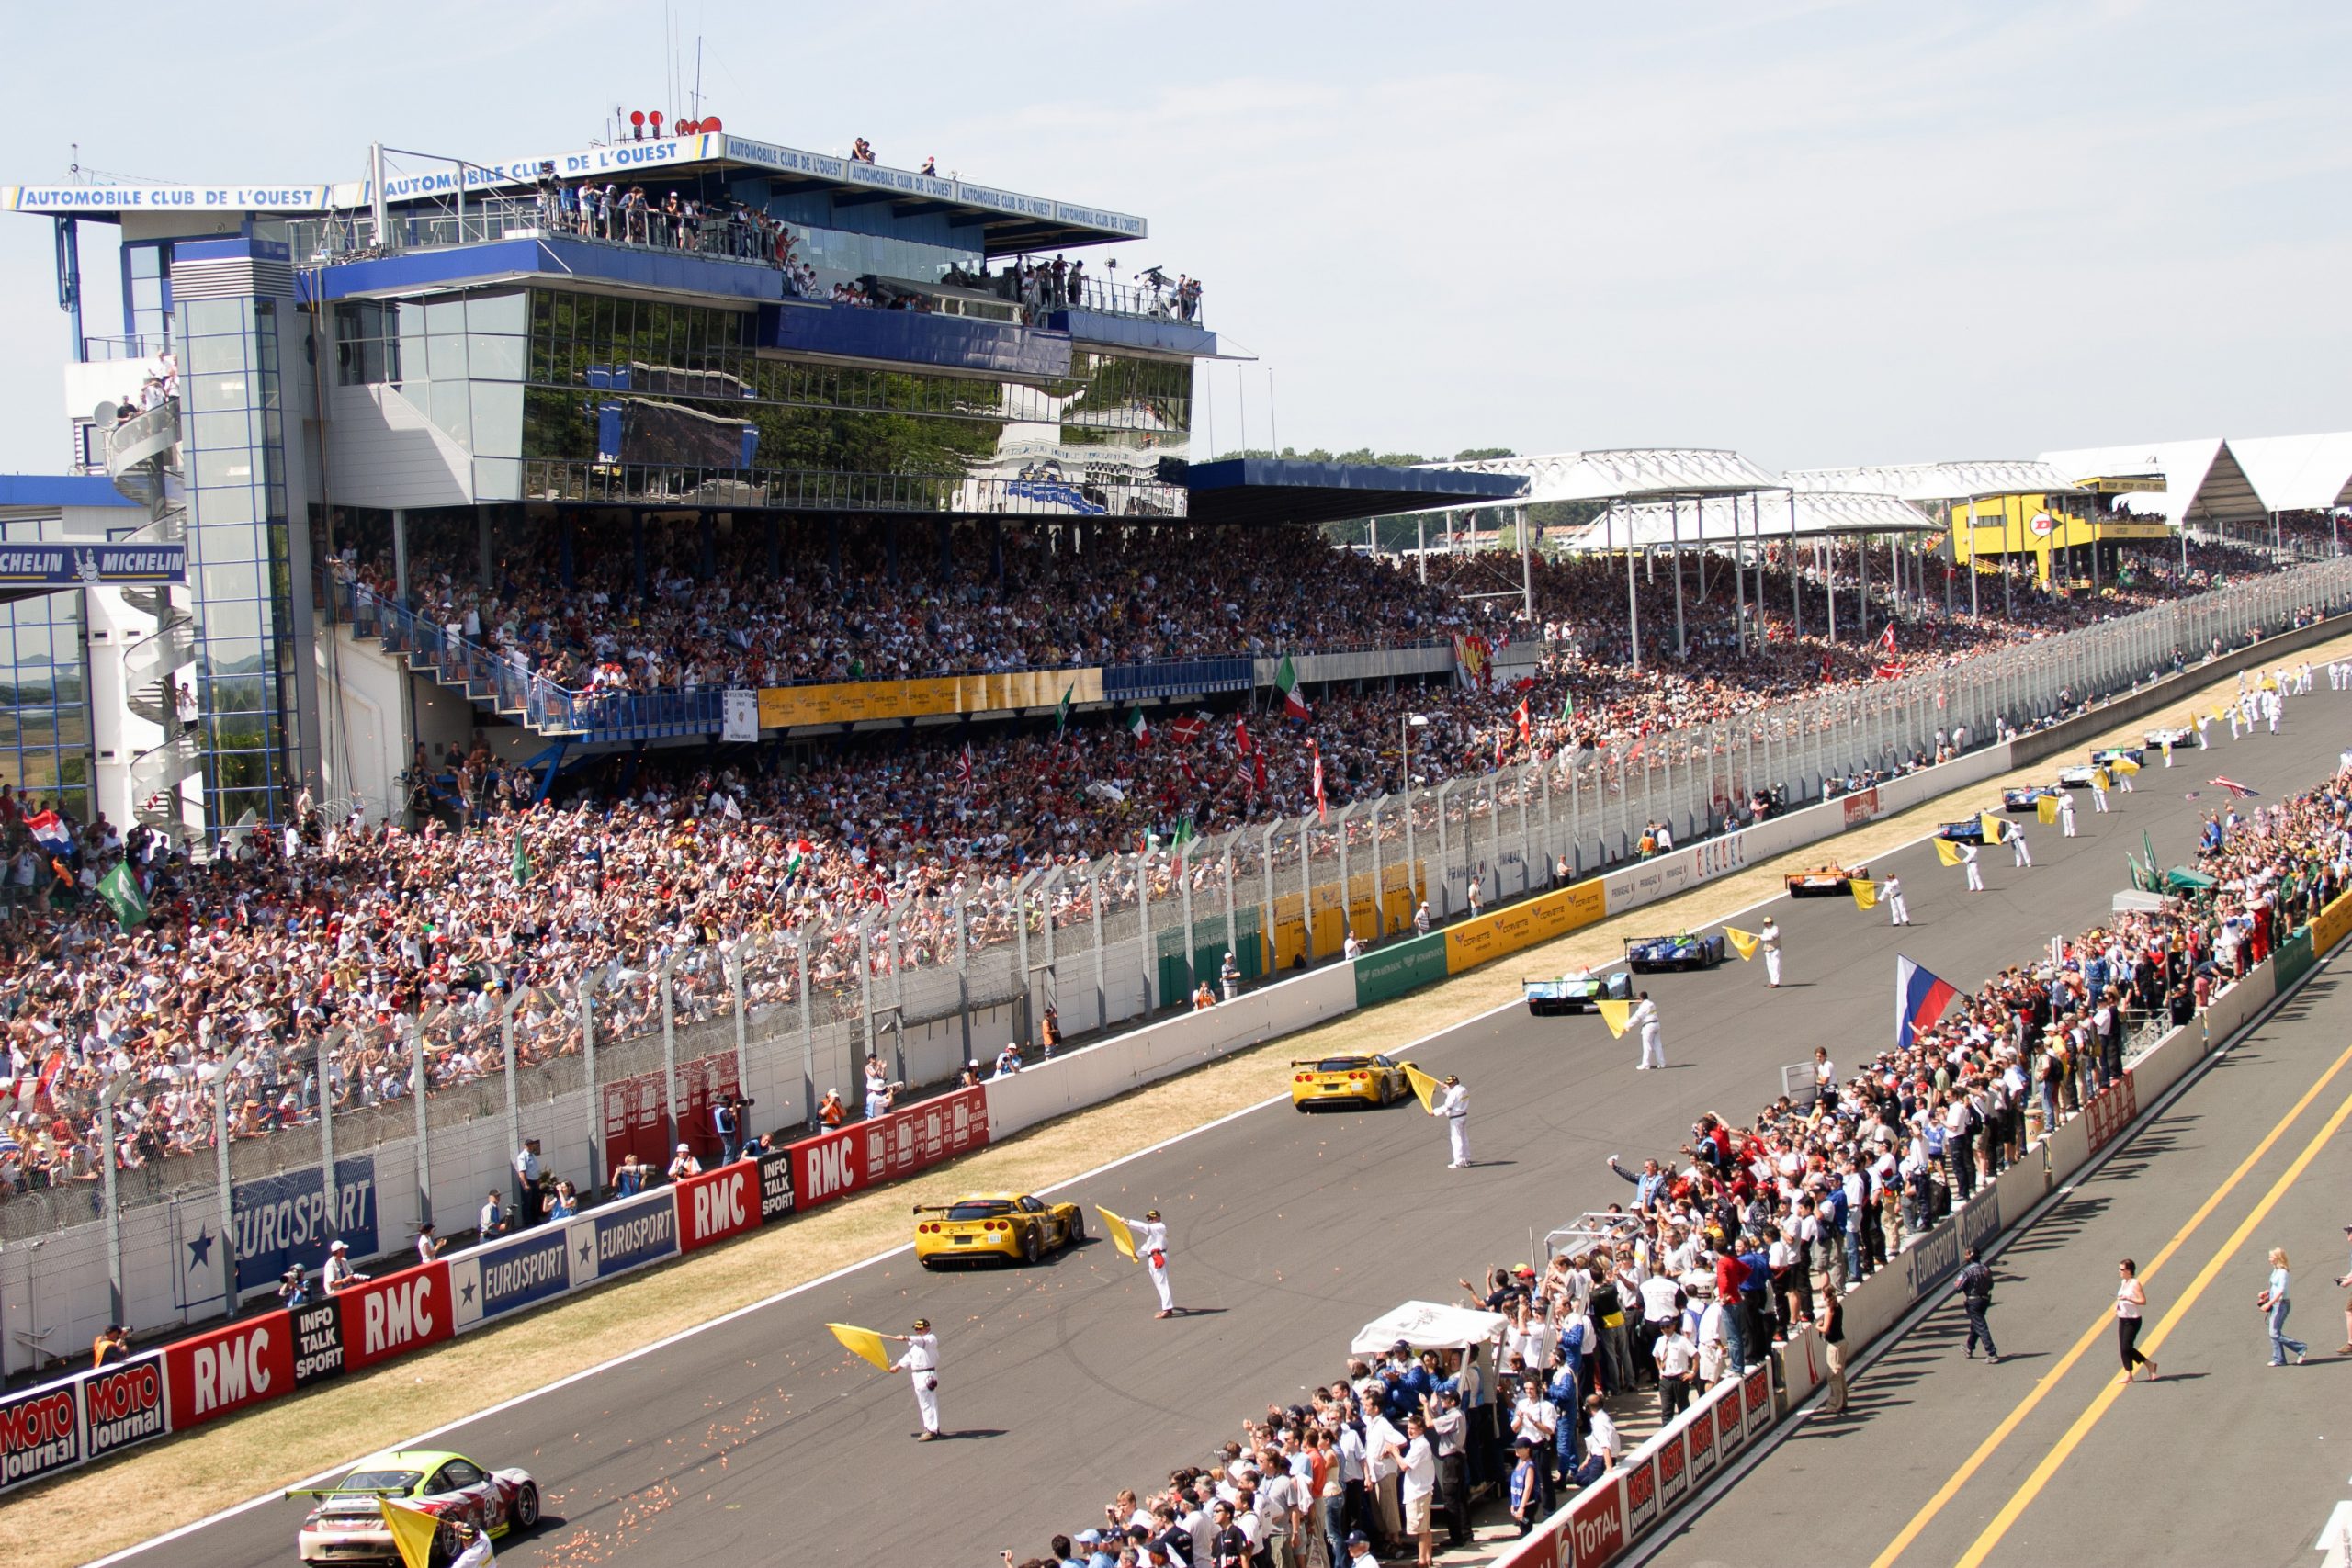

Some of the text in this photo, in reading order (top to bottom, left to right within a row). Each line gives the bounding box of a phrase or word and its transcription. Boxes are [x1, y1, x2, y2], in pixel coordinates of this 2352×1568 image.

[568, 155, 589, 171] DE
[601, 142, 677, 167] L'OUEST
[730, 141, 842, 176] AUTOMOBILE CLUB DE L'OUEST
[26, 189, 313, 205] AUTOMOBILE CLUB DE L'OUEST
[852, 165, 952, 197] AUTOMOBILE CLUB DE L'OUEST
[961, 187, 1051, 216] AUTOMOBILE CLUB DE L'OUEST
[1059, 207, 1140, 232] AUTOMOBILE CLUB DE L'OUEST
[102, 553, 184, 572] MICHELIN
[764, 1157, 787, 1179] INFO
[764, 1175, 789, 1196] TALK
[807, 1136, 854, 1200] RMC
[694, 1172, 746, 1240] RMC
[762, 1191, 794, 1216] SPORT
[600, 1208, 673, 1260] EUROSPORT
[1917, 1228, 1955, 1284] EUROSPORT
[485, 1244, 565, 1301] EUROSPORT
[300, 1306, 334, 1334] INFO
[365, 1275, 433, 1356] RMC
[300, 1326, 336, 1354] TALK
[194, 1327, 271, 1416] RMC
[296, 1347, 344, 1379] SPORT
[87, 1363, 160, 1426] MOTO
[1717, 1390, 1740, 1438] MOTO
[1746, 1370, 1767, 1414] MOTO
[0, 1391, 74, 1456] MOTO
[1689, 1412, 1713, 1460] MOTO
[1659, 1437, 1683, 1484] MOTO
[485, 1497, 496, 1517] 90
[1627, 1461, 1653, 1509] MOTO
[1577, 1505, 1620, 1560] TOTAL
